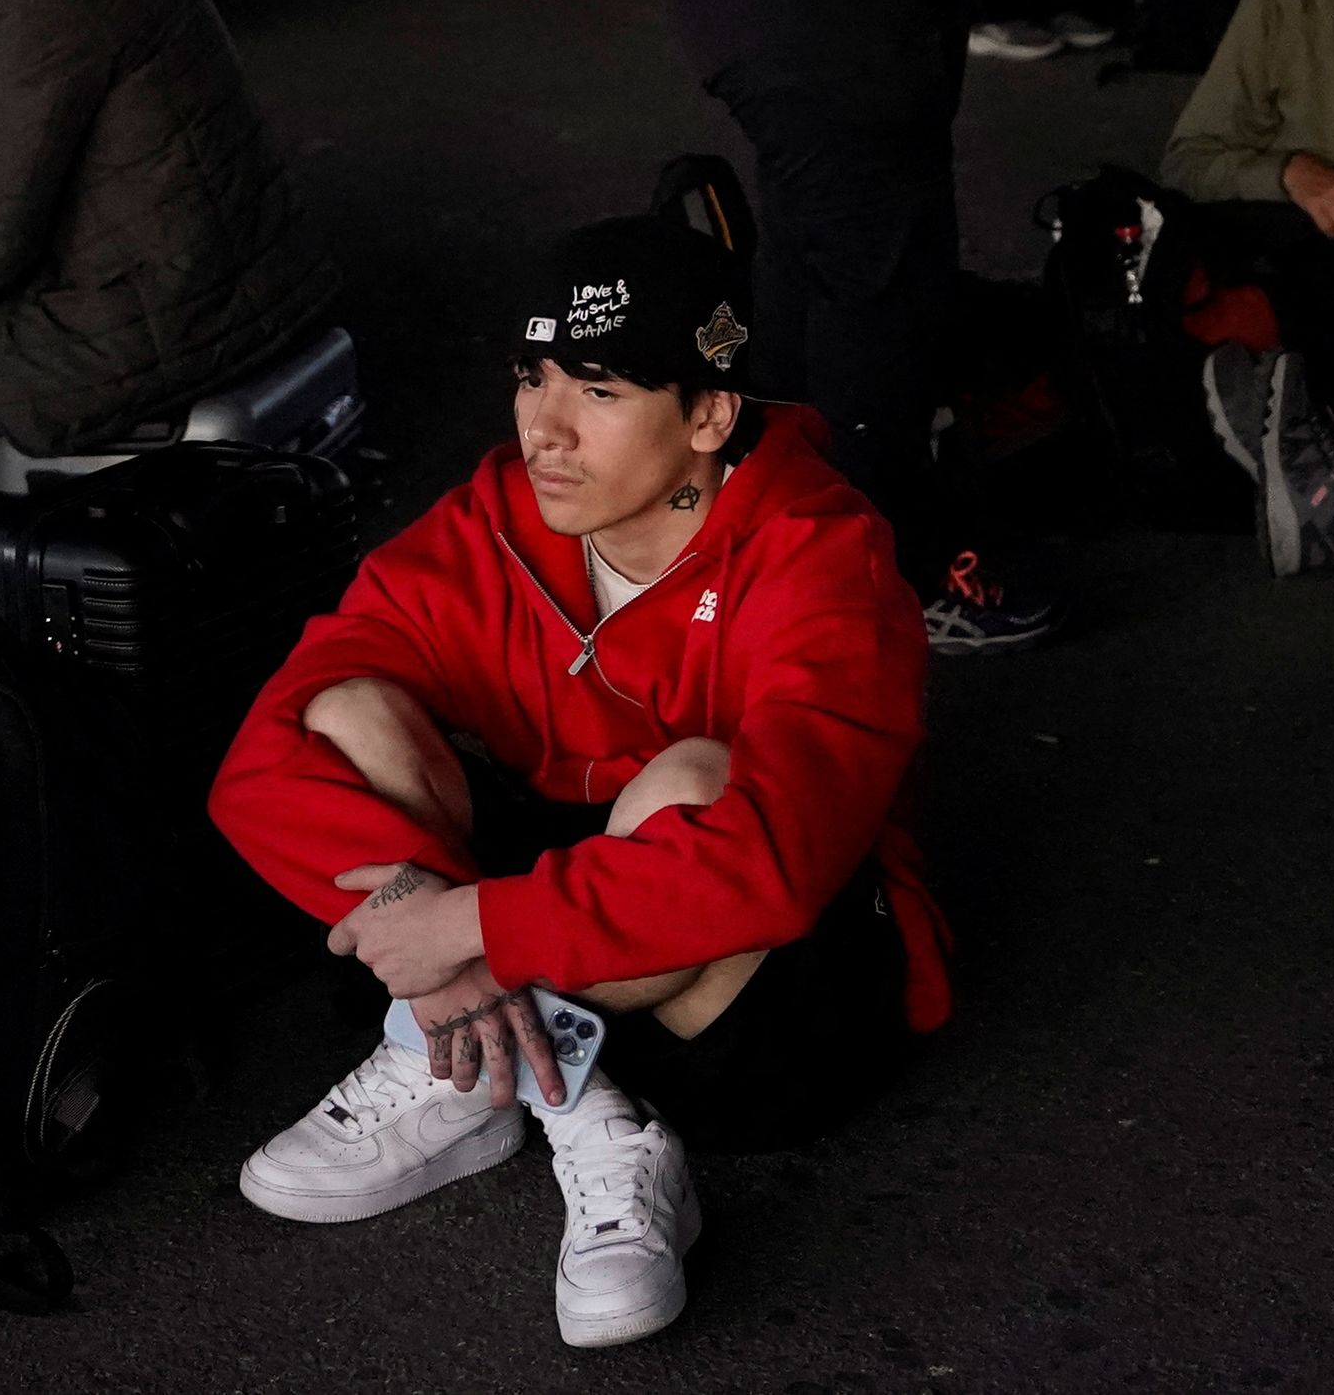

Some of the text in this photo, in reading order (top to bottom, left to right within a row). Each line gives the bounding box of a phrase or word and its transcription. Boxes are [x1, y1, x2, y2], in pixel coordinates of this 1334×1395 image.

[572, 278, 628, 306] LOVE &
[567, 294, 631, 324] HUSTLE
[570, 315, 627, 340] GAME
